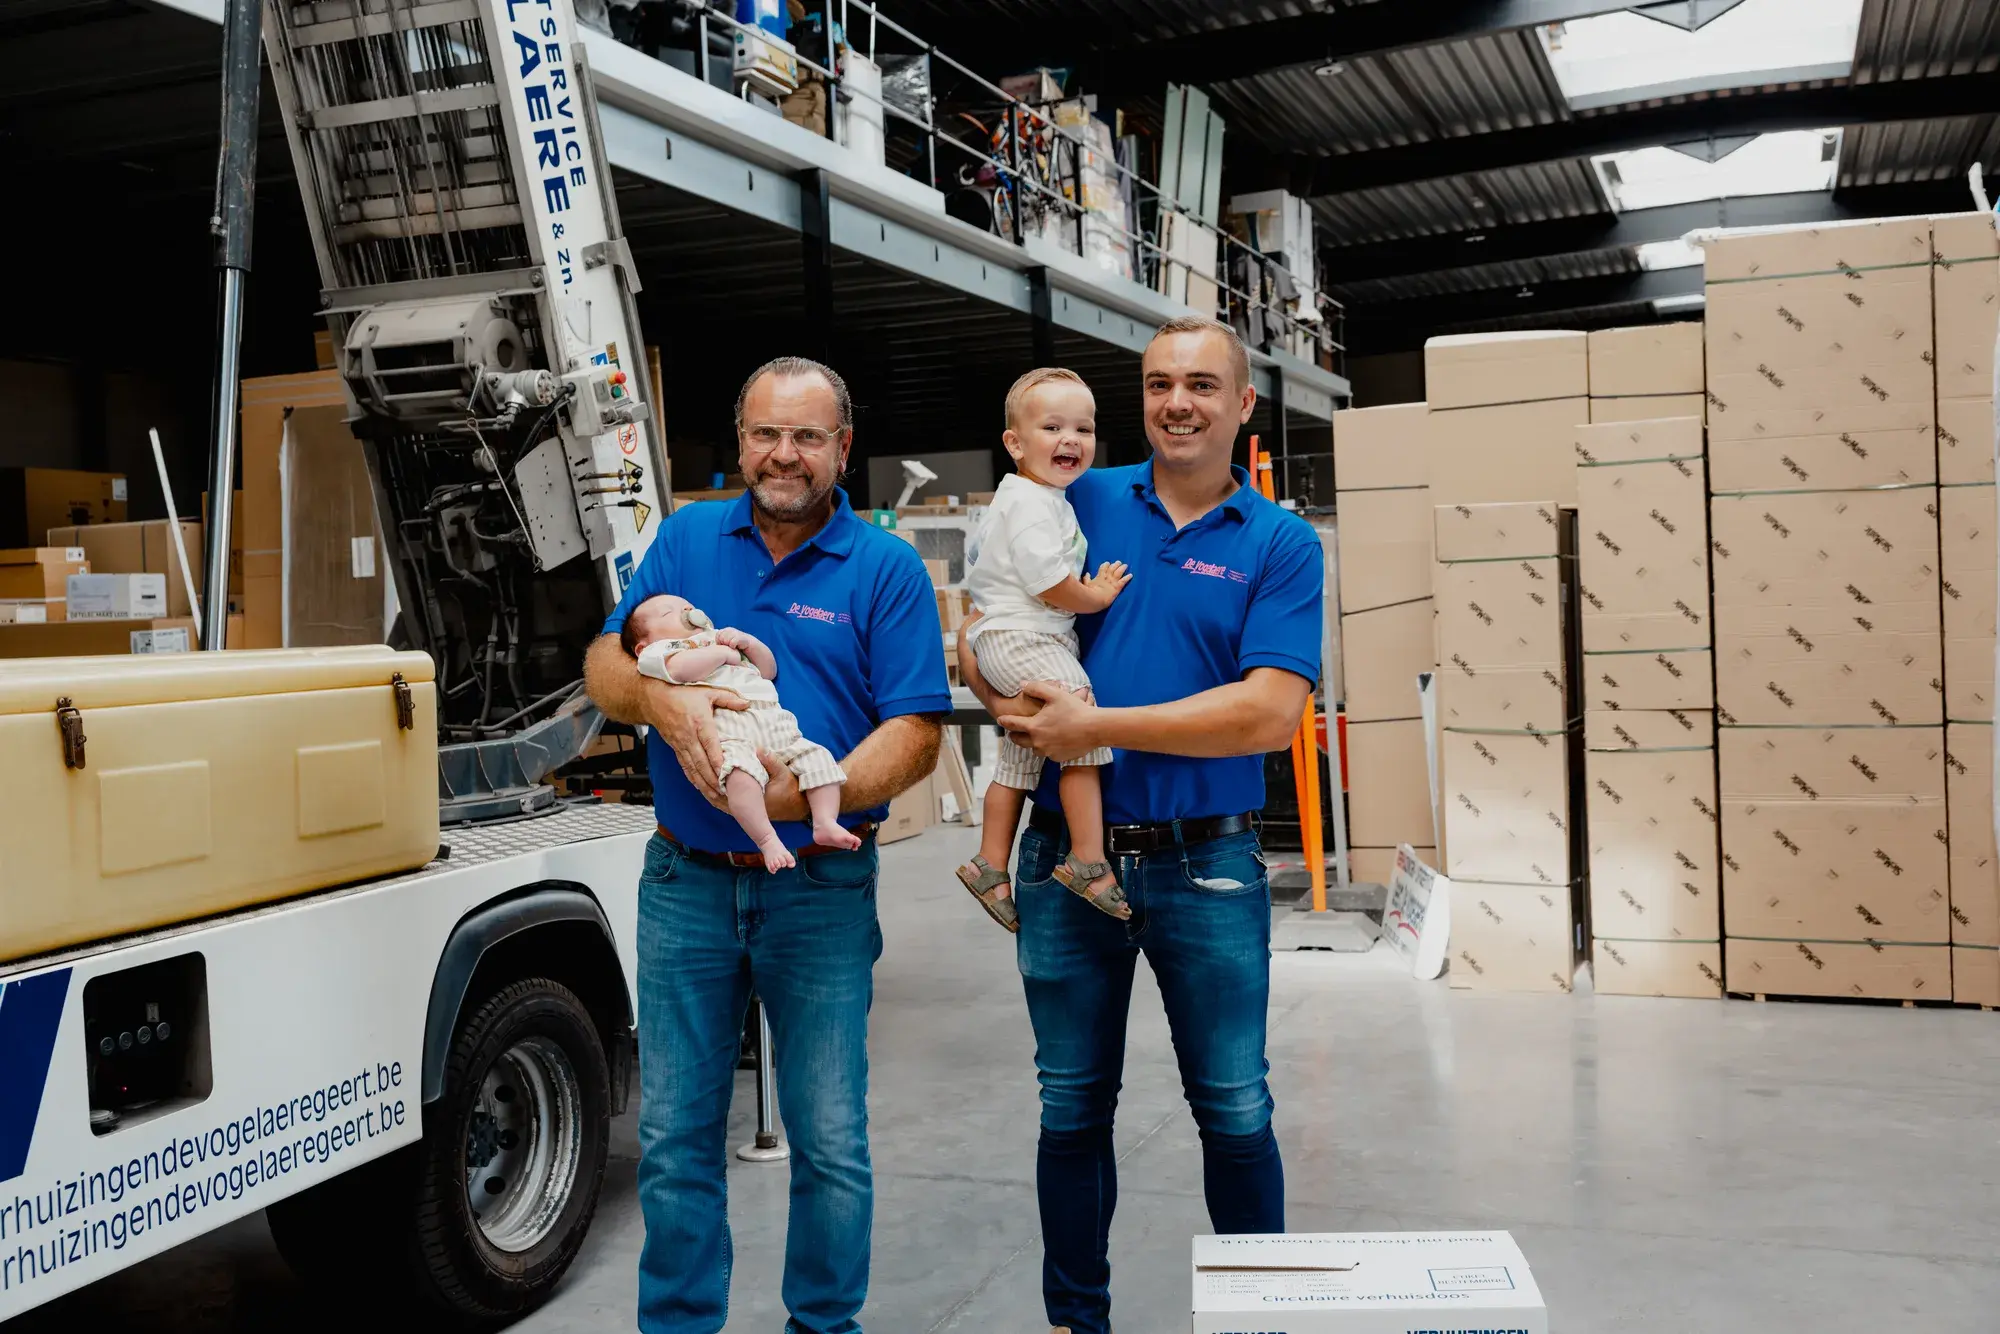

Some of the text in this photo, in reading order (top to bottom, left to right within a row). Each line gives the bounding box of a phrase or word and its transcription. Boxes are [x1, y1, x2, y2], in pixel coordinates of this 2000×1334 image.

[506, 0, 570, 214] LAERE
[552, 223, 564, 240] &
[1777, 306, 1804, 332] SieMatic
[1757, 363, 1785, 389] SieMatic
[1860, 374, 1889, 401] SieMatic
[1839, 432, 1868, 460] SieMatic
[1781, 455, 1810, 482] SieMatic
[1649, 508, 1677, 535] SieMatic
[1763, 512, 1791, 538] SieMatic
[1595, 530, 1622, 556] SieMatic
[1864, 526, 1893, 553] SieMatic
[1184, 558, 1196, 568] De
[789, 602, 801, 612] De
[801, 604, 835, 621] Vogelaere
[1468, 600, 1493, 626] SieMatic
[1673, 598, 1701, 624] SieMatic
[1786, 626, 1814, 652] SieMatic
[1451, 653, 1476, 678] SieMatic
[1655, 653, 1683, 679] SieMatic
[1766, 681, 1794, 707] SieMatic
[1472, 739, 1497, 765] SieMatic
[1849, 754, 1878, 783] SieMatic
[1597, 778, 1624, 804] SieMatic
[1791, 773, 1819, 800] SieMatic
[1772, 829, 1801, 856] SieMatic
[1873, 848, 1903, 876] SieMatic
[1460, 950, 1484, 975] SieMatic
[1797, 942, 1825, 970] SieMatic
[0, 1061, 403, 1240] rhuizingendevogelaeregeert.be
[1262, 1293, 1470, 1302] Circulaire verhuisdoos
